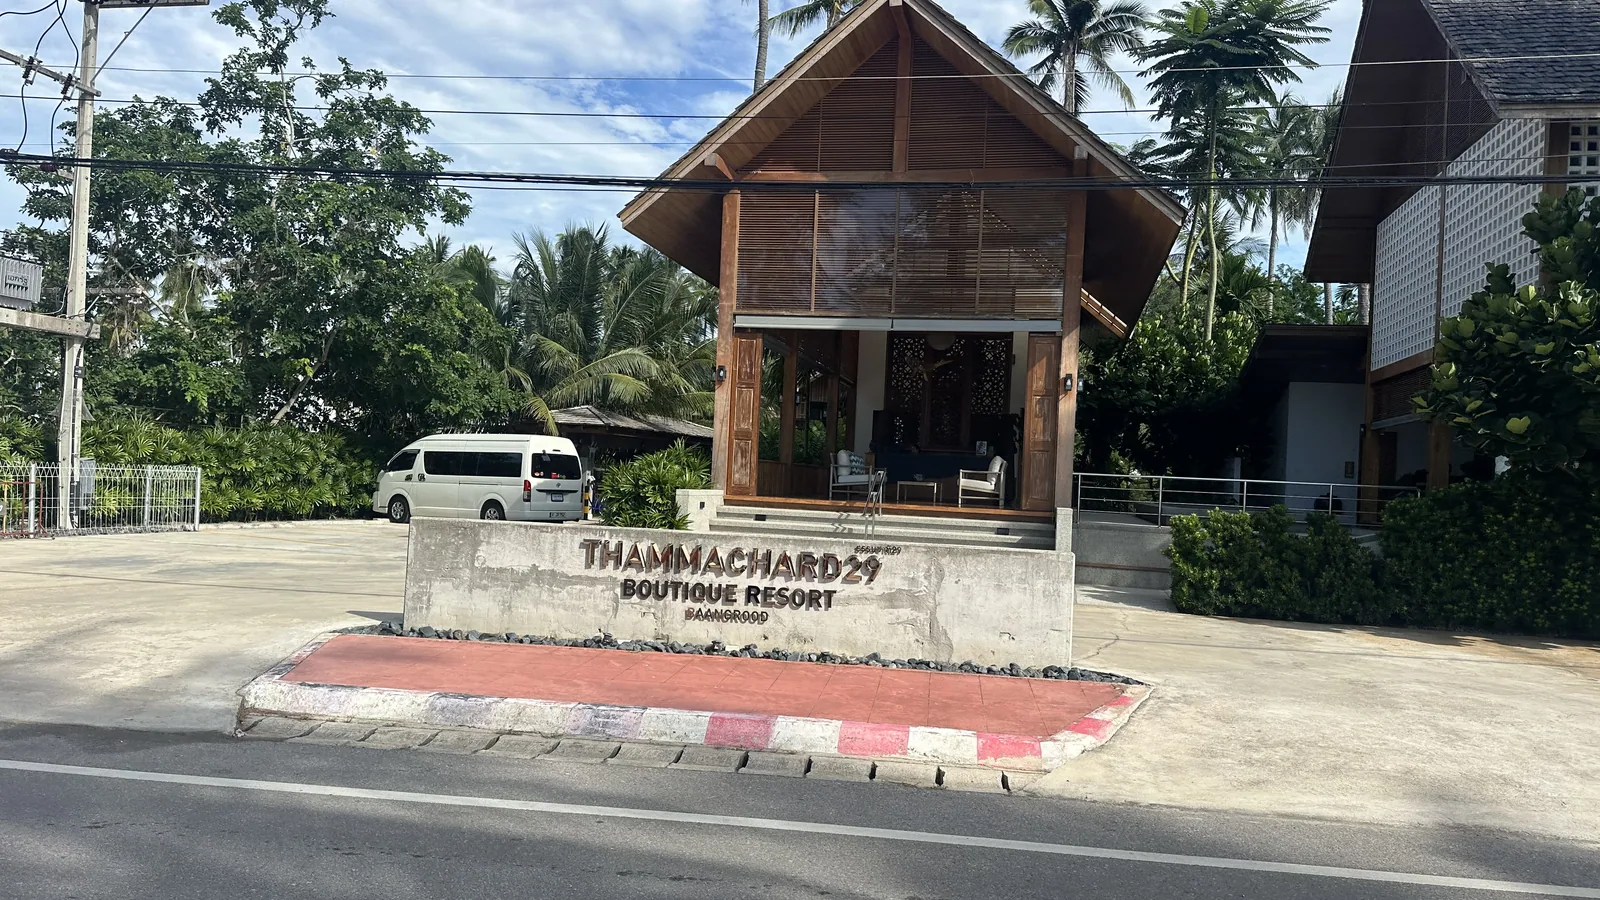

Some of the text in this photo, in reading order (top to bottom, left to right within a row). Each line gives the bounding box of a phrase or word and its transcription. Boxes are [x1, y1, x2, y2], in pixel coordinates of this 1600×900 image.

[580, 539, 882, 585] THAMMACHARD29
[621, 578, 837, 610] BOUTIQUE RESORT
[685, 607, 769, 623] BAANGROOD
